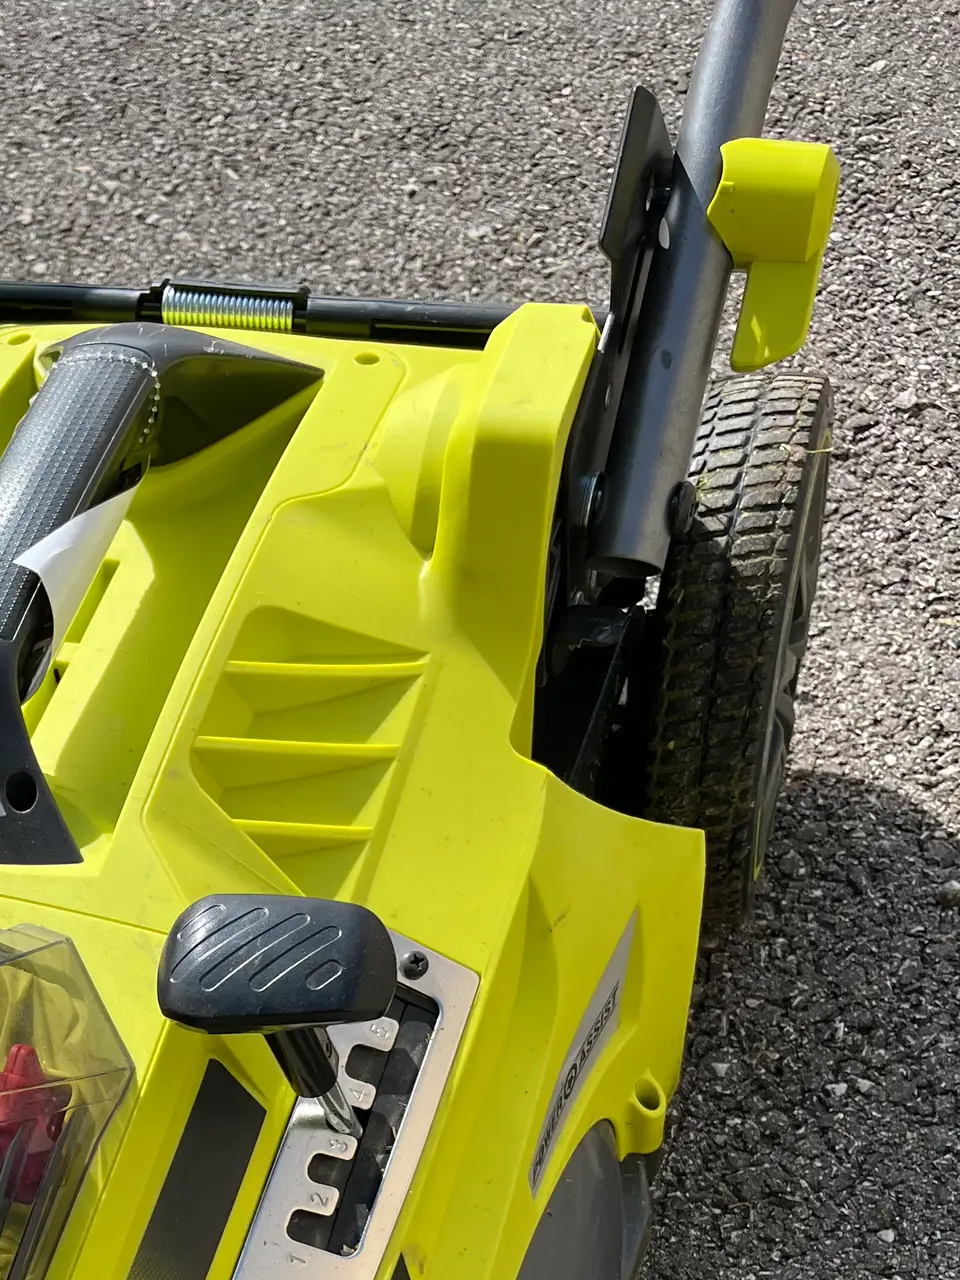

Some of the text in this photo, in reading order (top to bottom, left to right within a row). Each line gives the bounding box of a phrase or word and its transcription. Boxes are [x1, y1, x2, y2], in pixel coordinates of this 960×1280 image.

[370, 1023, 389, 1039] 5
[533, 987, 619, 1187] POWER ASSIST
[349, 1087, 367, 1102] 4
[329, 1138, 348, 1152] 3
[310, 1192, 329, 1206] 2
[288, 1253, 306, 1264] 1
